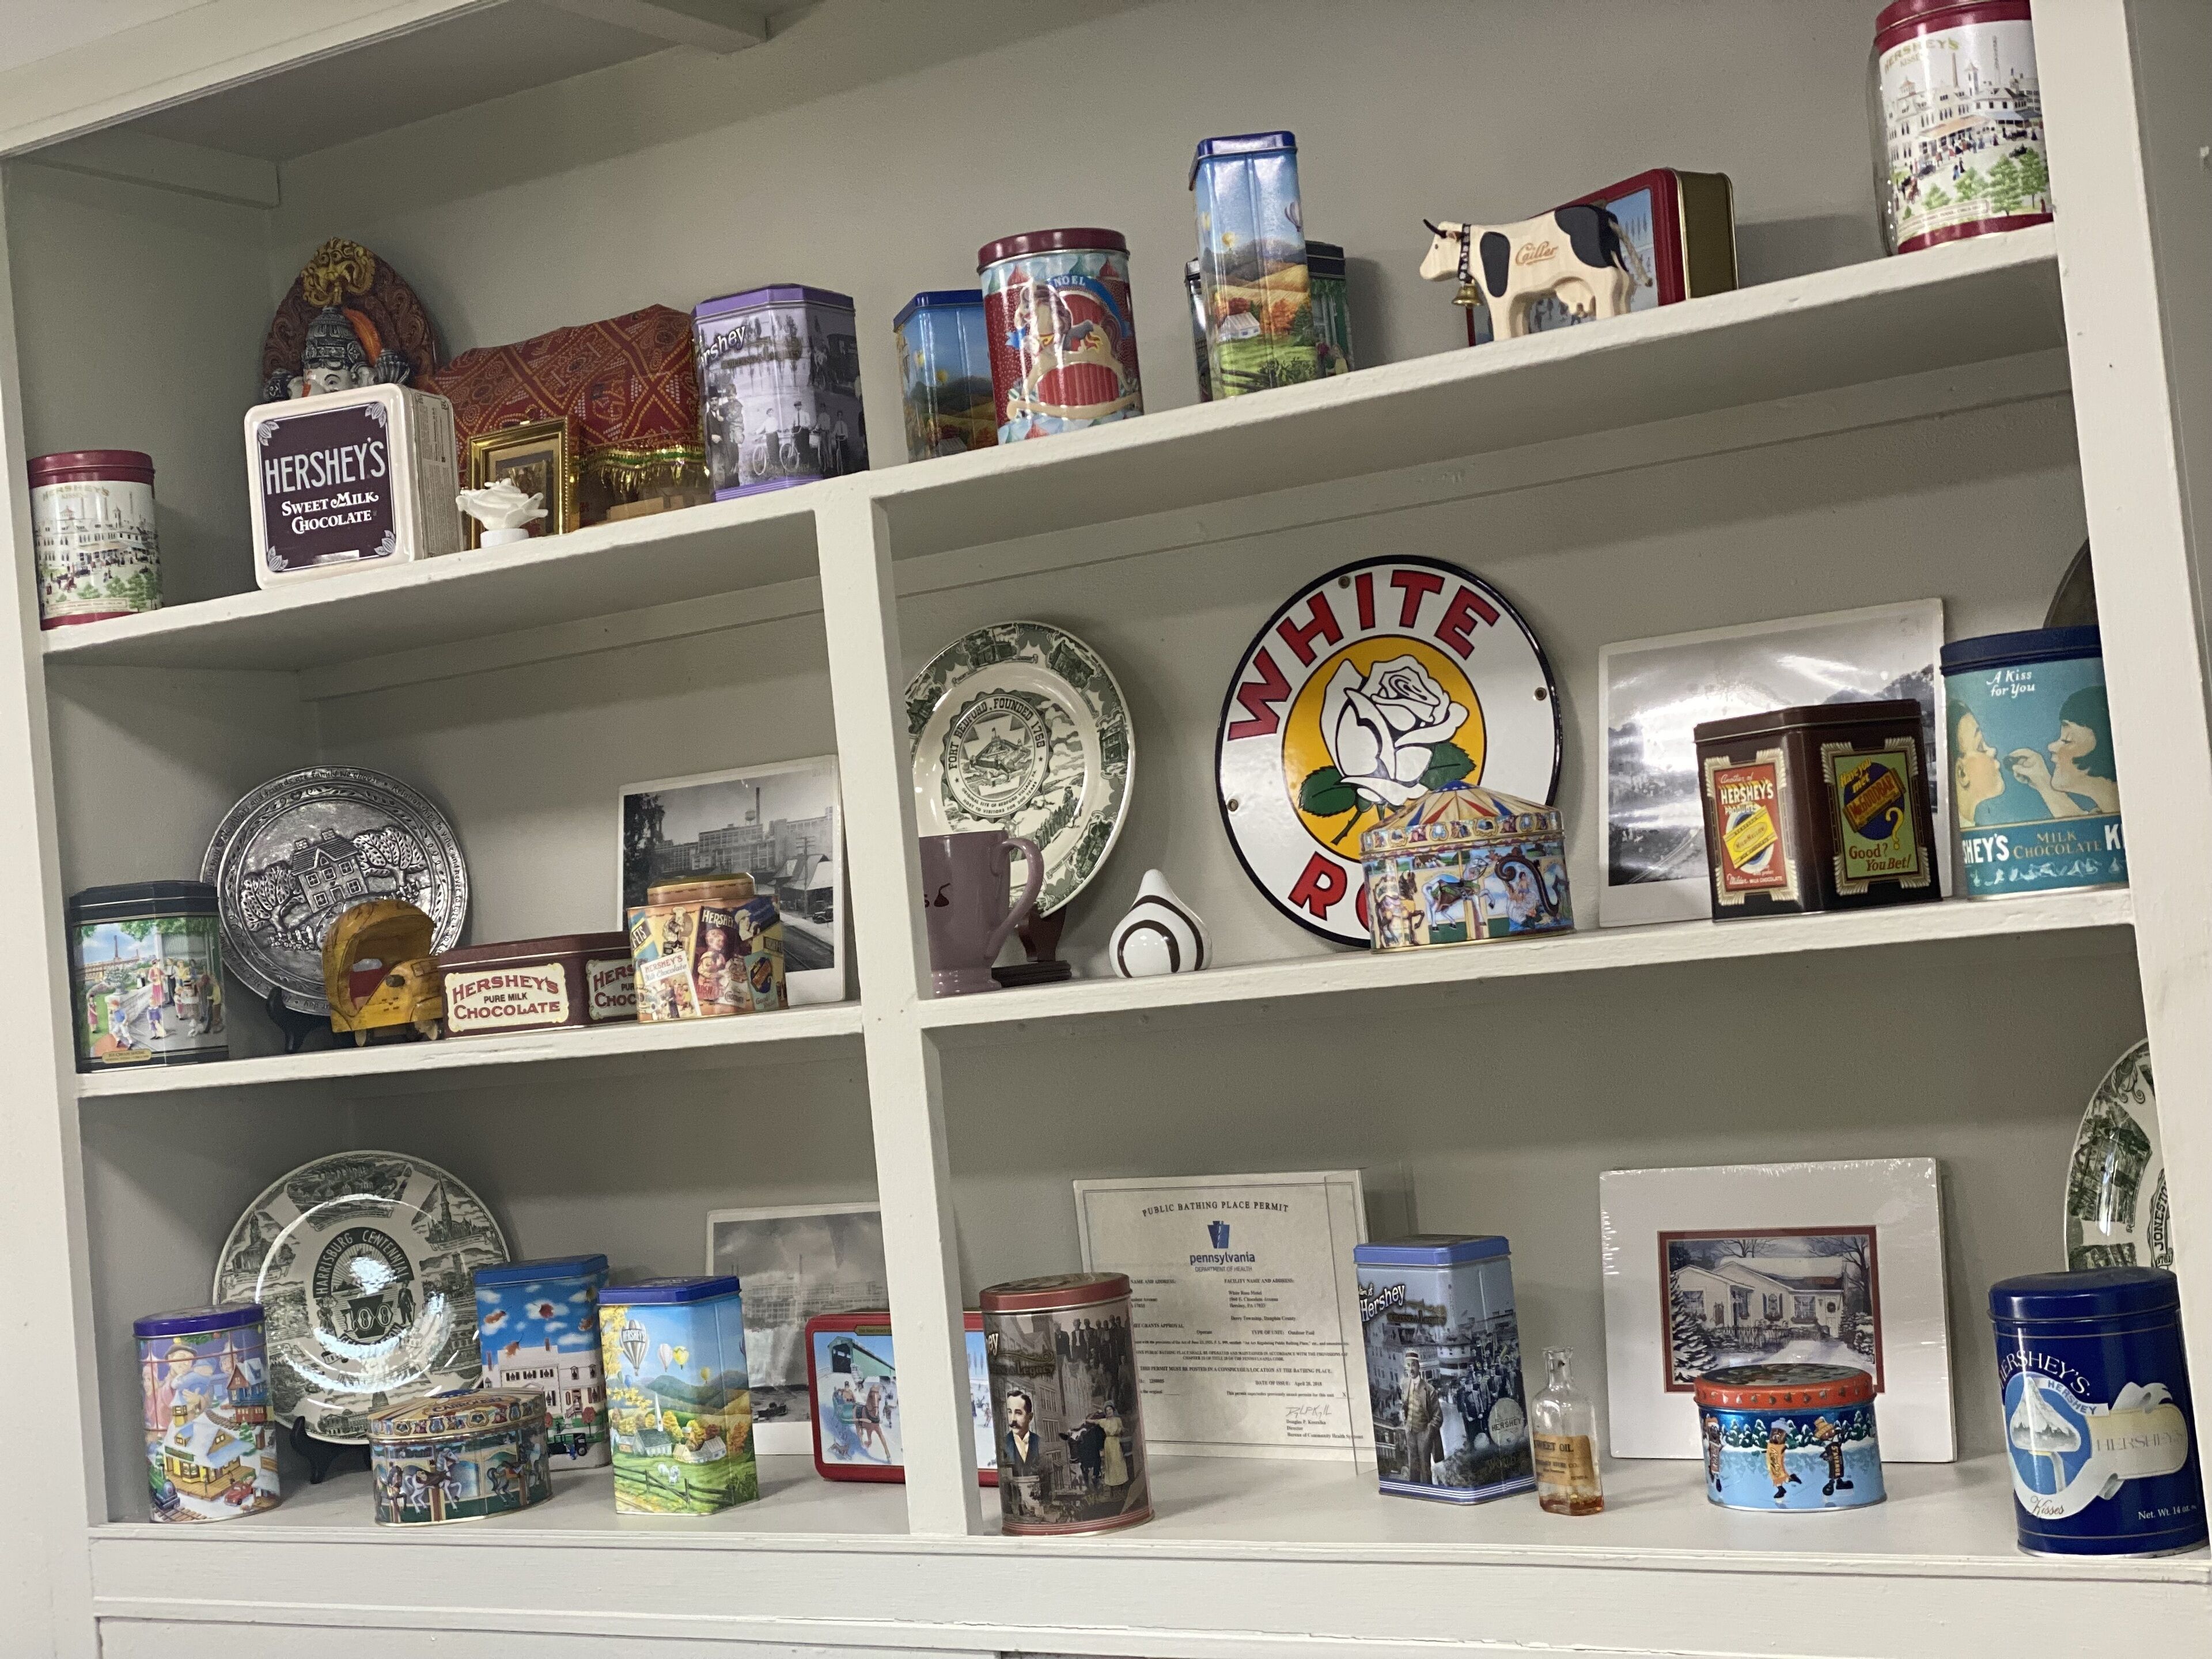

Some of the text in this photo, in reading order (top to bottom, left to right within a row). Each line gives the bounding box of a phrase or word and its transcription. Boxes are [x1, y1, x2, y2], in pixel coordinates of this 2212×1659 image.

[1514, 241, 1559, 265] Cailler
[1054, 275, 1086, 288] NOEL
[266, 436, 387, 495] HERSHEY'S
[281, 491, 379, 516] SWEET MILK
[291, 510, 372, 535] CHOCOLATE
[1227, 569, 1501, 741] WHITE
[1986, 669, 2032, 685] A Kiss
[1991, 683, 2035, 699] for You
[948, 741, 959, 770] FORT
[993, 697, 1035, 721] FOUNDED
[310, 769, 338, 778] family
[962, 787, 979, 805] ORIGINAL
[998, 796, 1018, 806] BEDFORD
[963, 799, 975, 809] HOST
[1027, 781, 1037, 796] YEARS
[1719, 778, 1774, 805] HERSHEY'S
[2036, 830, 2078, 844] MILK
[1849, 842, 1888, 860] Good?
[2013, 840, 2103, 860] CHOCOLATE
[1865, 854, 1912, 872] You Bet!
[453, 975, 560, 1005] HERSHEY'S
[621, 982, 635, 992] PUR
[483, 991, 528, 1005] PURE MILK
[453, 1001, 561, 1020] CHOCOLATE
[1142, 1200, 1289, 1217] PUBLIC BATHING PLACE PERMIT
[315, 1230, 410, 1295] HARRISBURG CENTENNIAL
[1189, 1251, 1256, 1266] pennsylvania
[1360, 1285, 1405, 1322] Hershey
[343, 1302, 394, 1333] 100
[2047, 1380, 2097, 1415] HERSHEY
[1491, 1418, 1522, 1432] HERSHEY
[1534, 1440, 1574, 1453] WEET OIL
[2029, 1495, 2065, 1517] Kisses
[2138, 1510, 2156, 1520] Net.
[2172, 1507, 2181, 1516] 14
